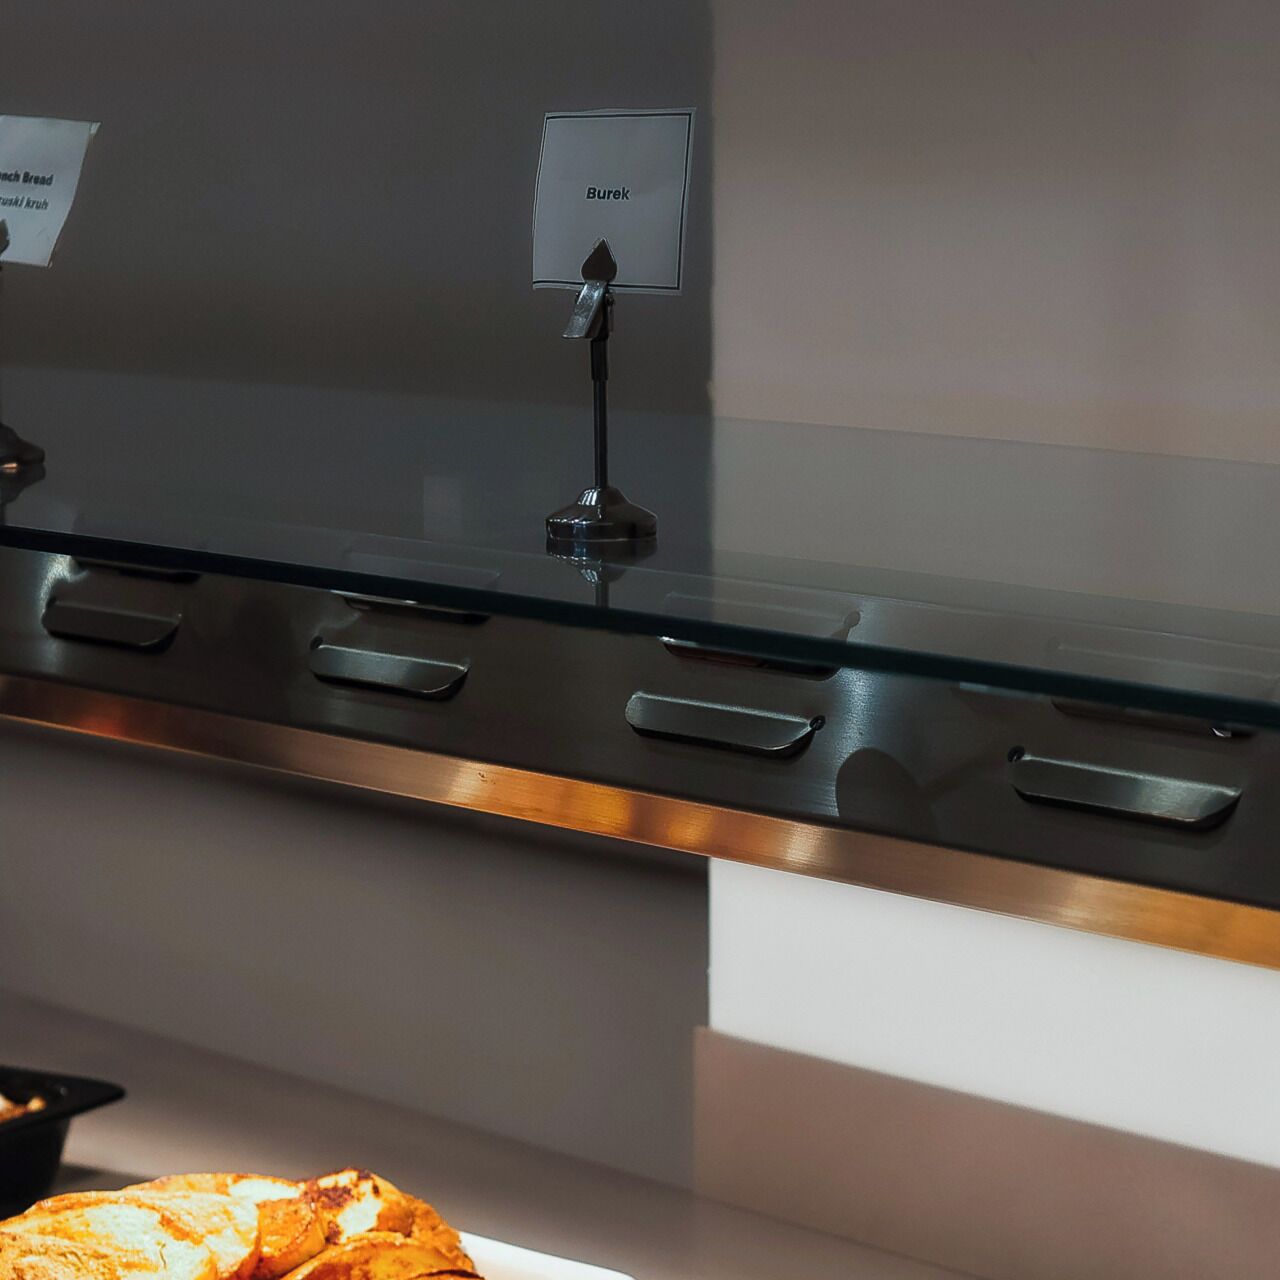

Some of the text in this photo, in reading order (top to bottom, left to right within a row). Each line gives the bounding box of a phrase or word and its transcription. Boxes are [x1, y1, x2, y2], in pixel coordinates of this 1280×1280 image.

[22, 171, 54, 186] Bread
[586, 187, 630, 200] Burek
[24, 196, 49, 210] kruh
